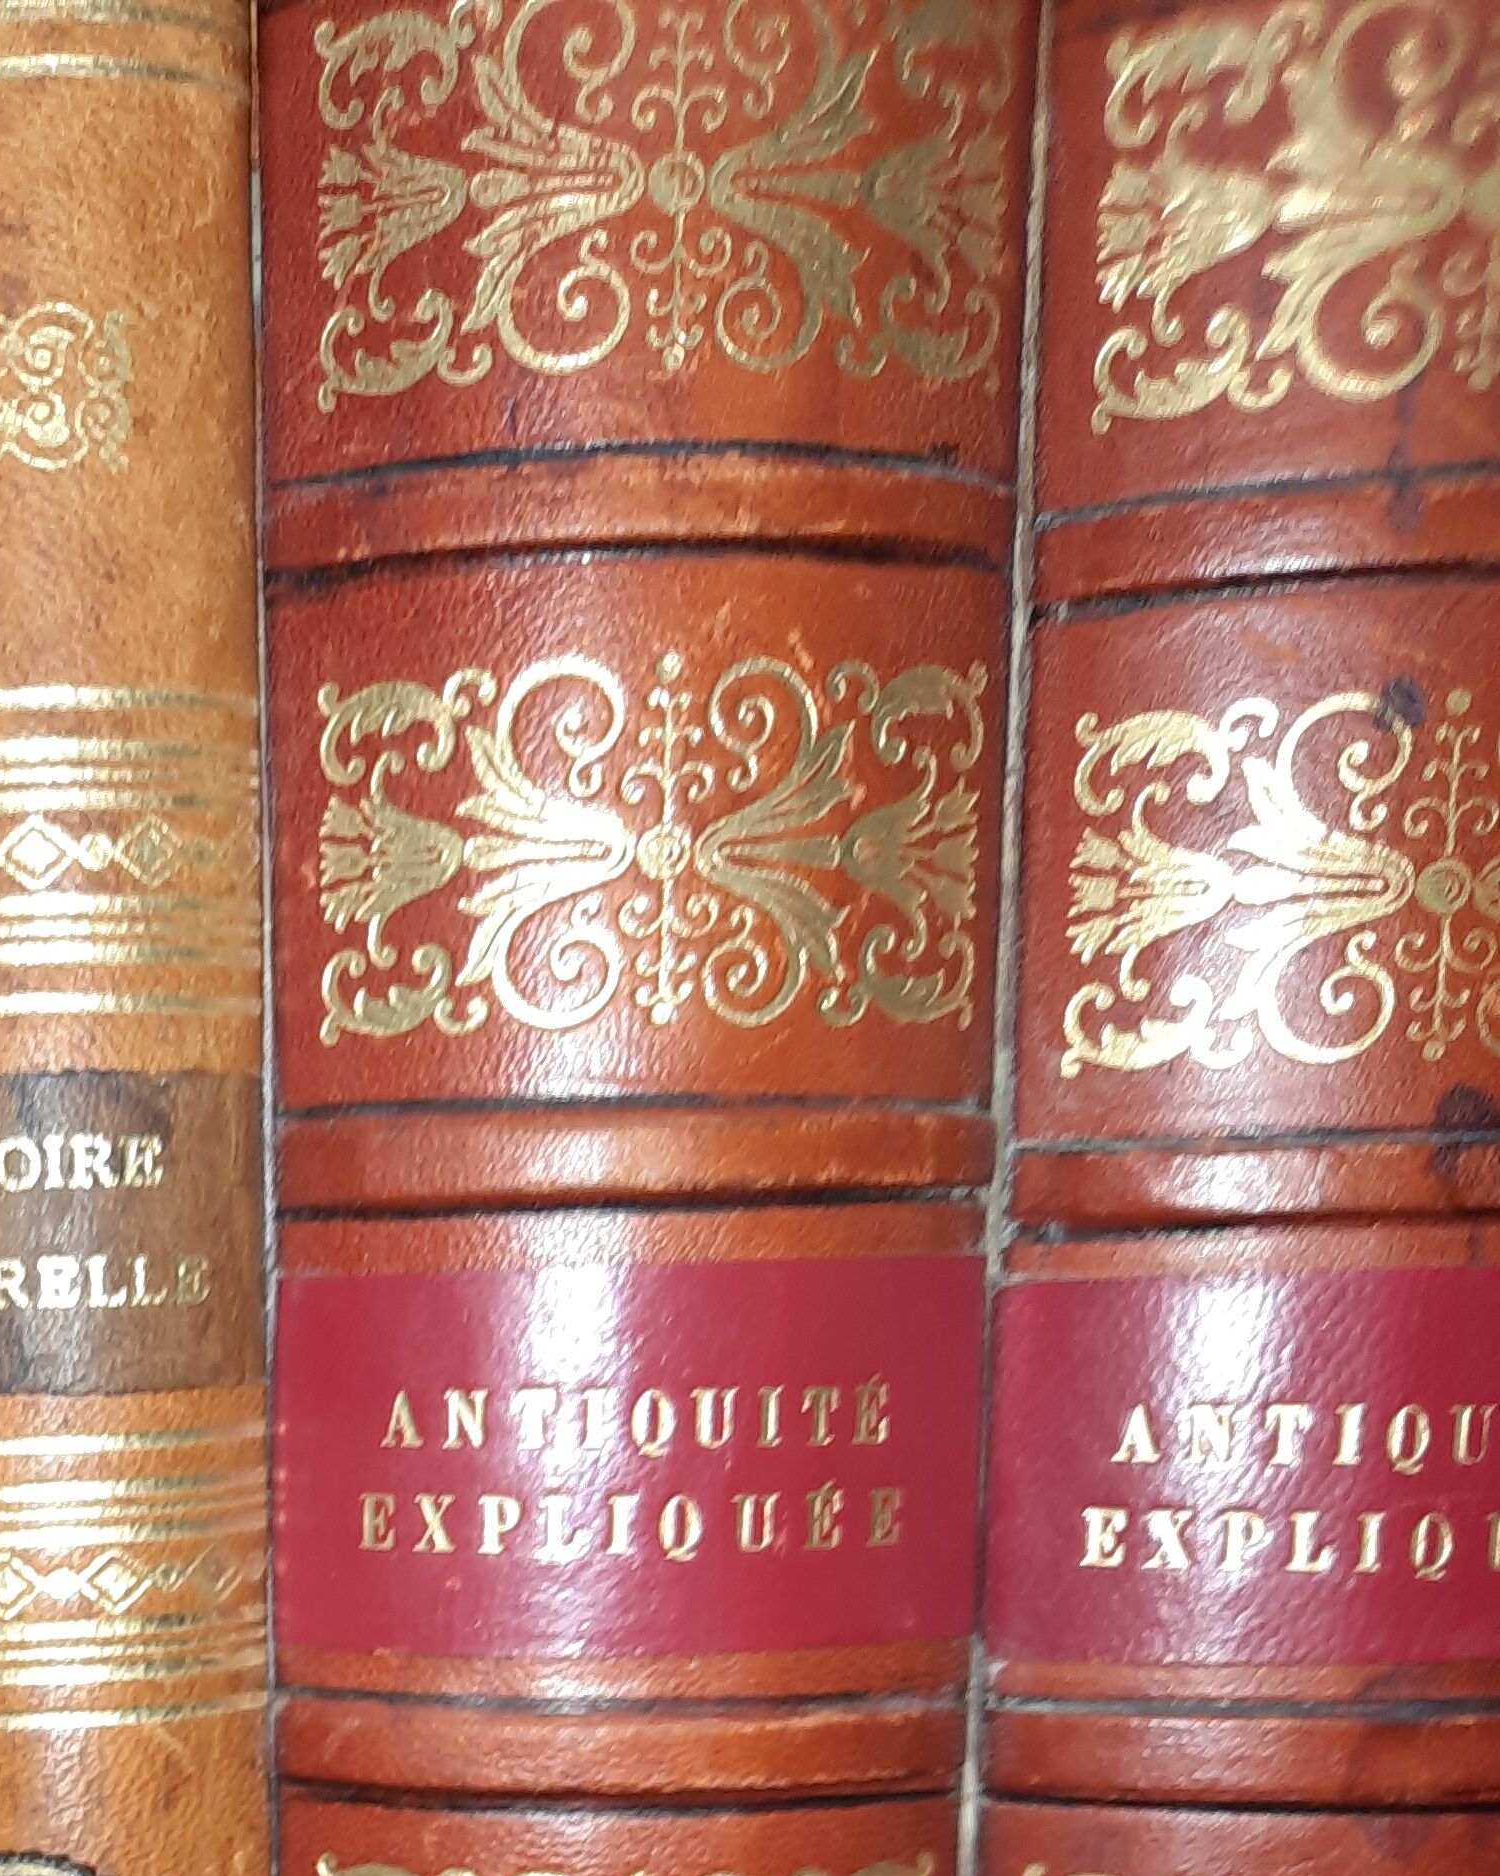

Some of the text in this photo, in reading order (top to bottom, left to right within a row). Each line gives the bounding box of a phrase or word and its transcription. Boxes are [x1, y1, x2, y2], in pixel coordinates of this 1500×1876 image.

[379, 1373, 892, 1457] ANTIQUITÉ
[1109, 1402, 1499, 1476] ANTIQU
[358, 1480, 904, 1563] EXPLIQUÉE
